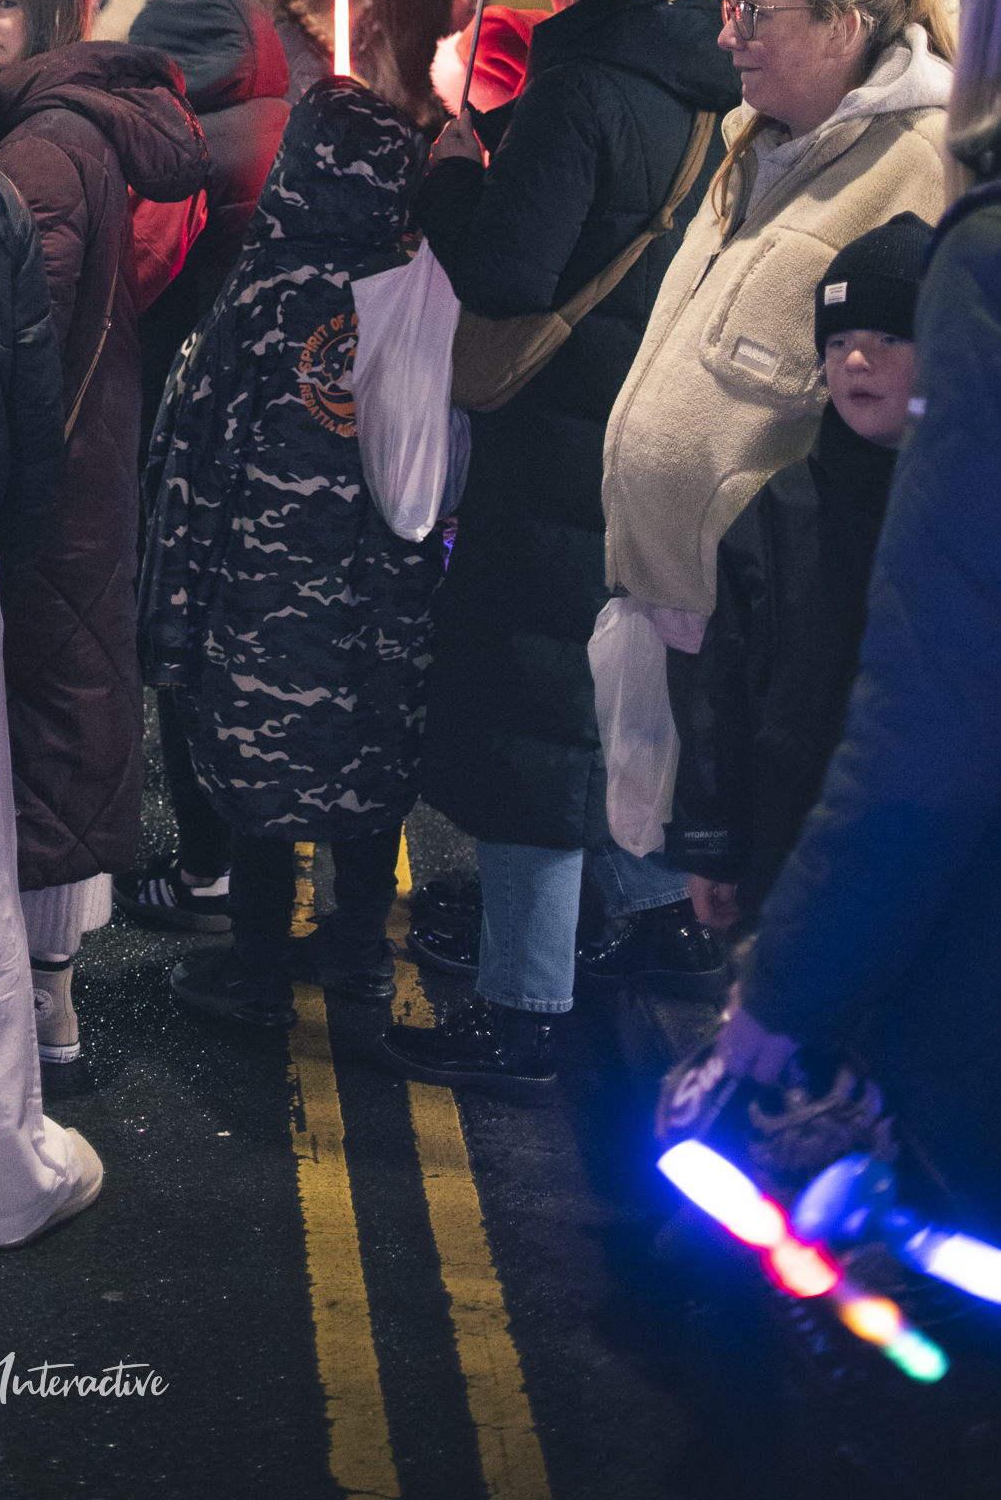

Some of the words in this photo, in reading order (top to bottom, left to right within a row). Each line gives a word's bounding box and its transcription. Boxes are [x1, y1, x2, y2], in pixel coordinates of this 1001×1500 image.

[298, 324, 329, 373] SPIRIT
[330, 313, 346, 331] OF
[299, 384, 335, 432] REGATTA
[684, 830, 728, 839] HYDRAFORT
